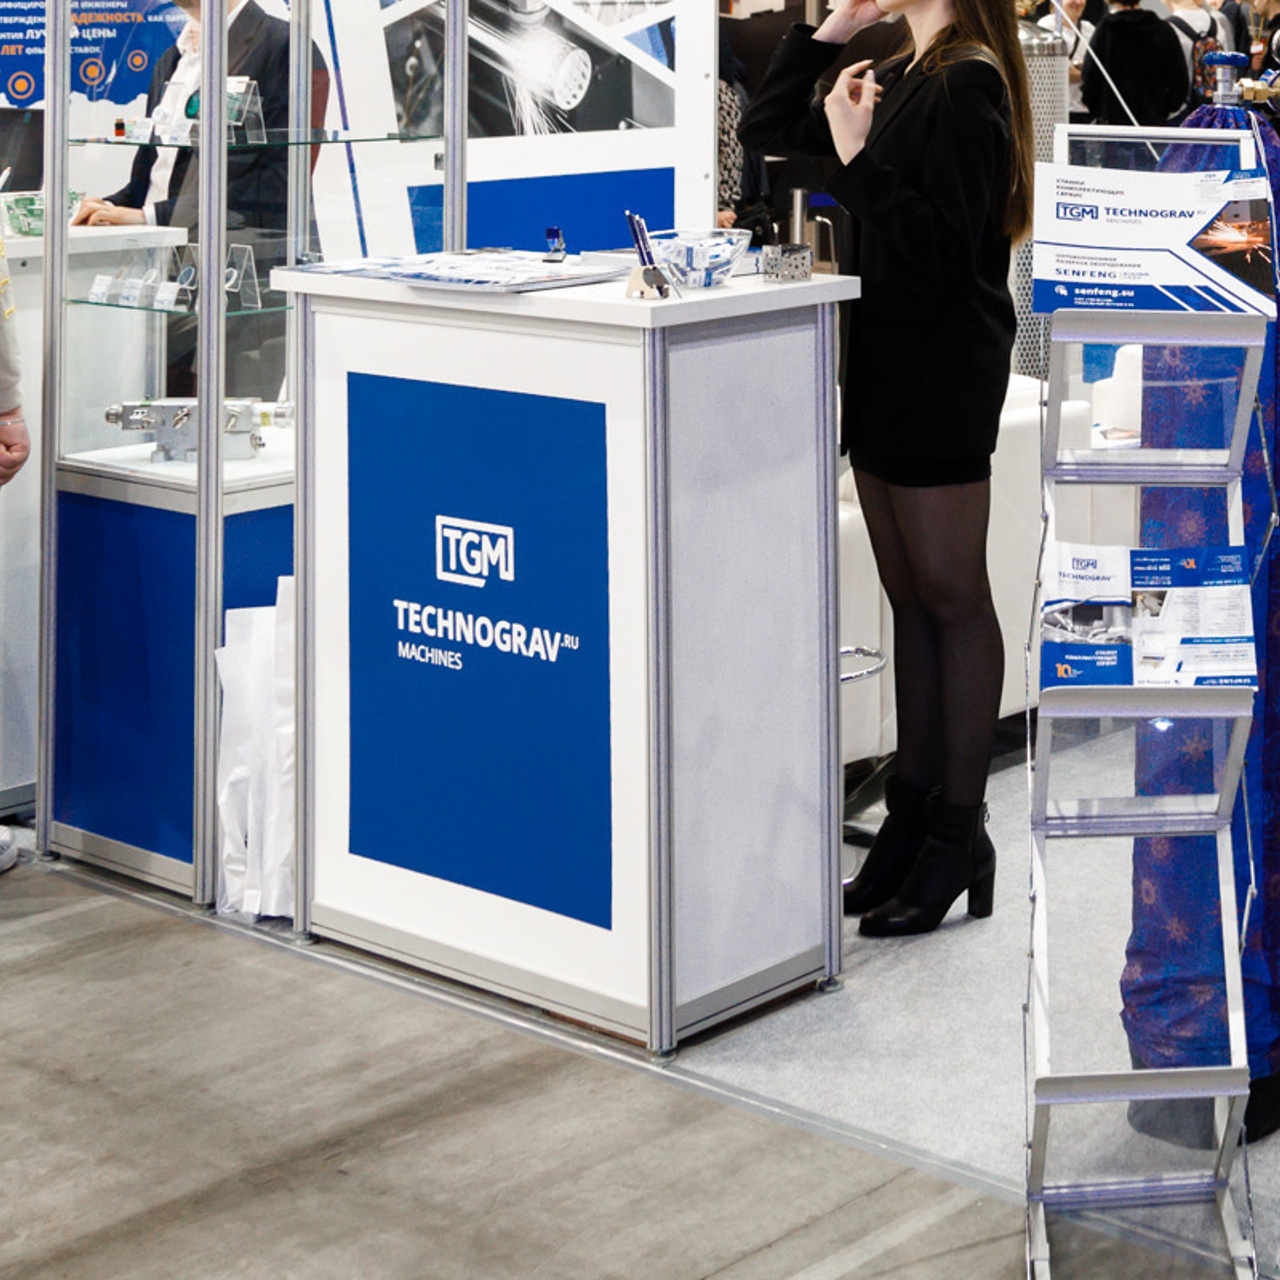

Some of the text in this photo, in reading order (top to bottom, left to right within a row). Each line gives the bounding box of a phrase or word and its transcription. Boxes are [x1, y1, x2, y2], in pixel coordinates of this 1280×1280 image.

[1059, 204, 1097, 220] TGM
[1055, 267, 1118, 279] SENFENG
[1073, 287, 1135, 298] senfeng.su
[440, 523, 508, 580] TGM
[397, 641, 463, 670] MACHINES
[1055, 663, 1071, 678] 10
